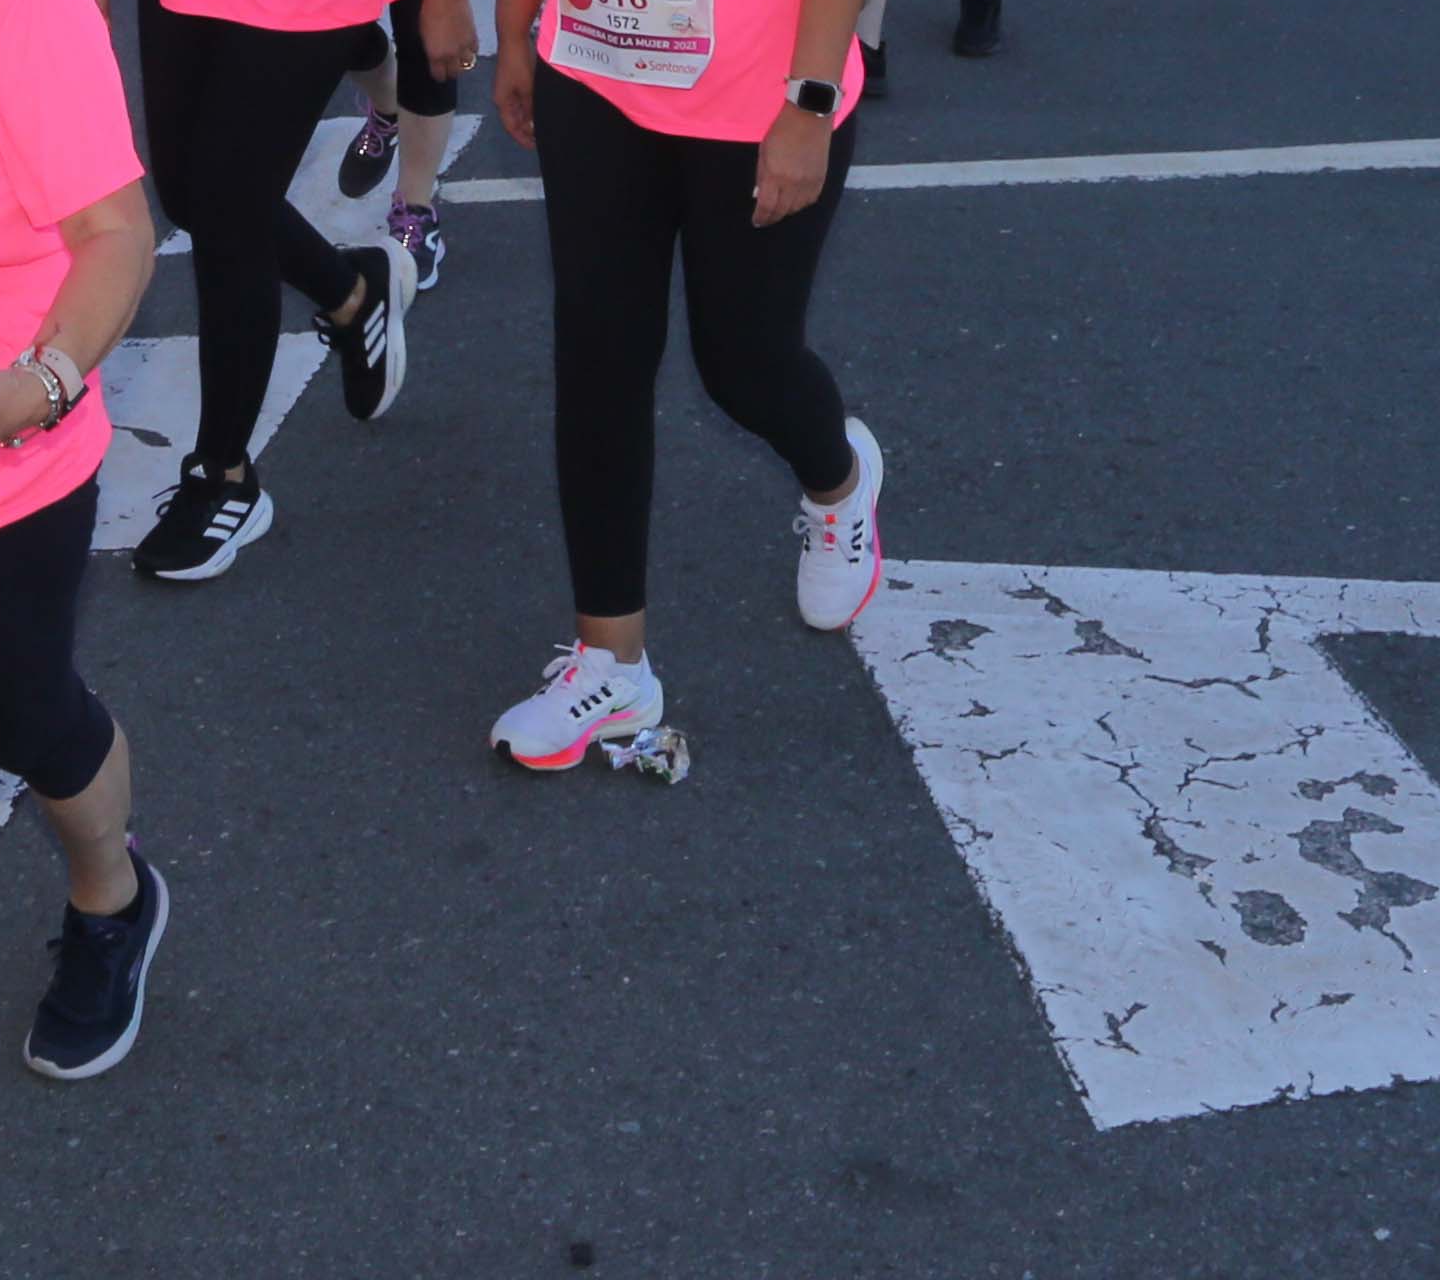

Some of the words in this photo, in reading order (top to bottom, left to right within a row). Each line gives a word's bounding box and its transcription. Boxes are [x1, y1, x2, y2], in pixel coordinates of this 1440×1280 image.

[607, 14, 640, 30] 1572
[573, 22, 608, 40] CARRERA
[608, 34, 618, 45] DE
[620, 36, 634, 47] LA
[636, 38, 670, 49] MUJER
[568, 43, 610, 65] OYSHO
